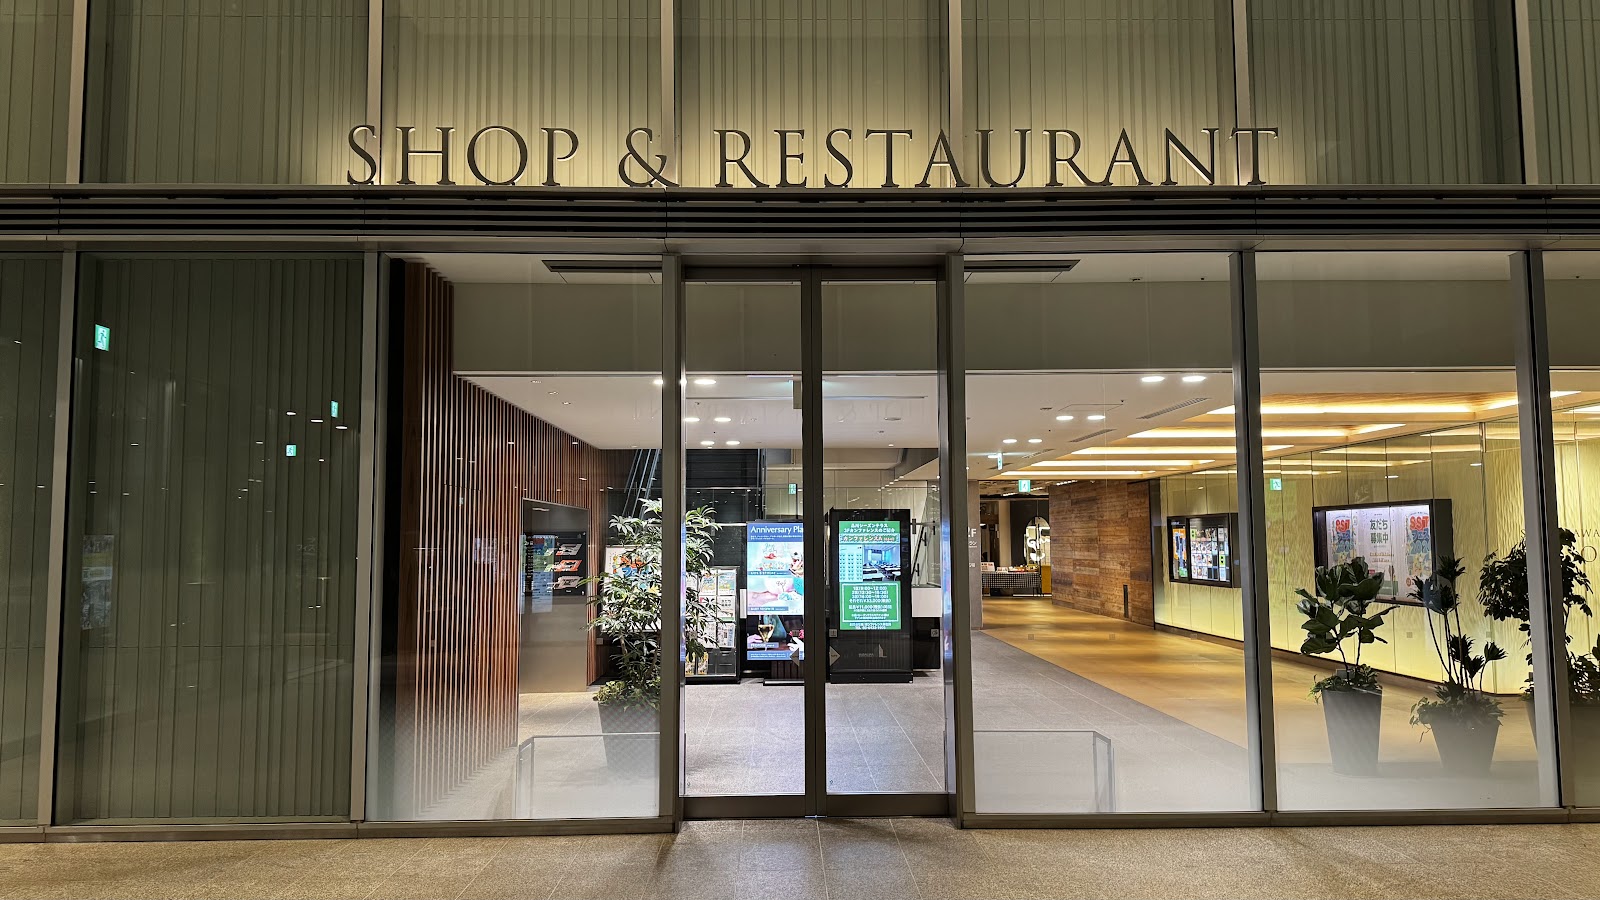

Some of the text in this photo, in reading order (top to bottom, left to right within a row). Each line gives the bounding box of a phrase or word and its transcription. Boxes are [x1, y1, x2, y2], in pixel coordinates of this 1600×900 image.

[346, 124, 1279, 188] SHOP & RESTAURANT
[750, 525, 803, 534] Anniversary Pla
[1369, 518, 1388, 531] 友だち
[1370, 532, 1389, 544] 募集中
